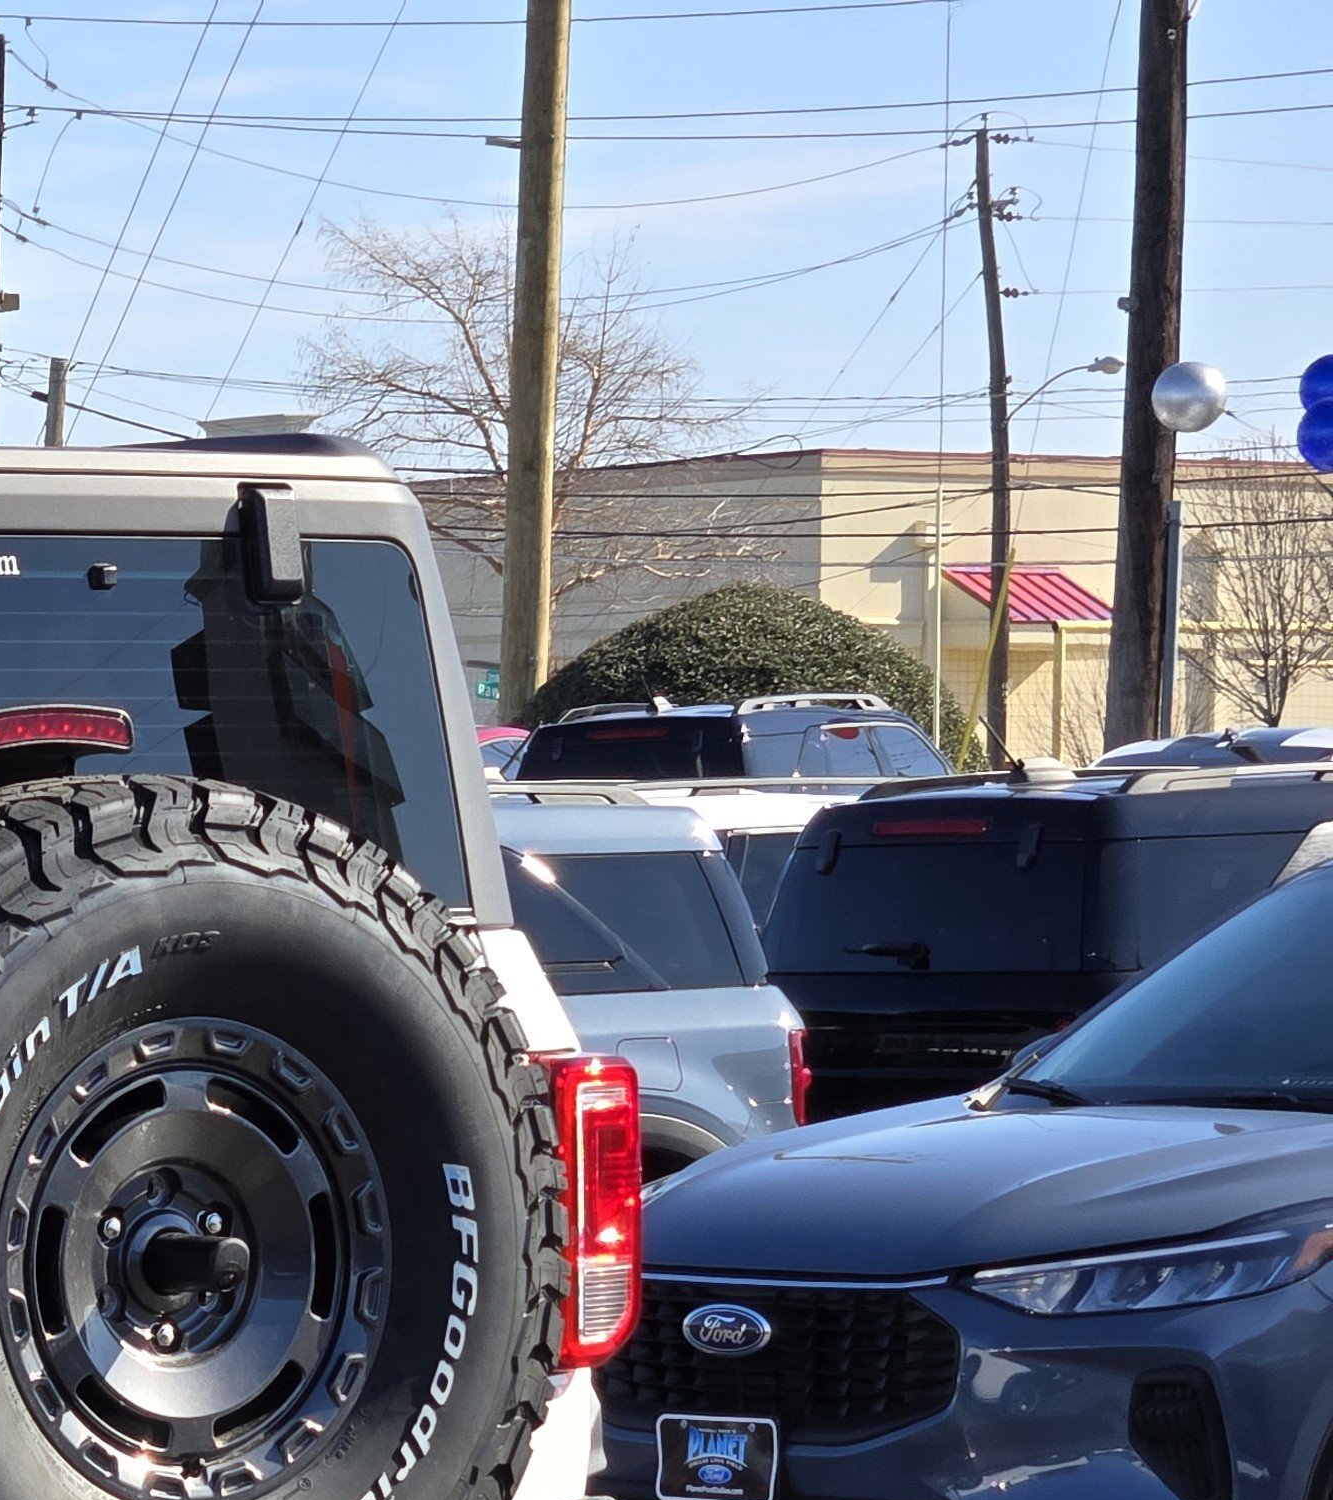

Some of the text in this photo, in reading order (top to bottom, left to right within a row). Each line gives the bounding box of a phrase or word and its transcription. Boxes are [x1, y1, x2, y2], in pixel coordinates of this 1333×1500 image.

[59, 945, 143, 1018] T/A
[699, 1314, 747, 1344] Ford
[687, 1425, 748, 1463] PLANET
